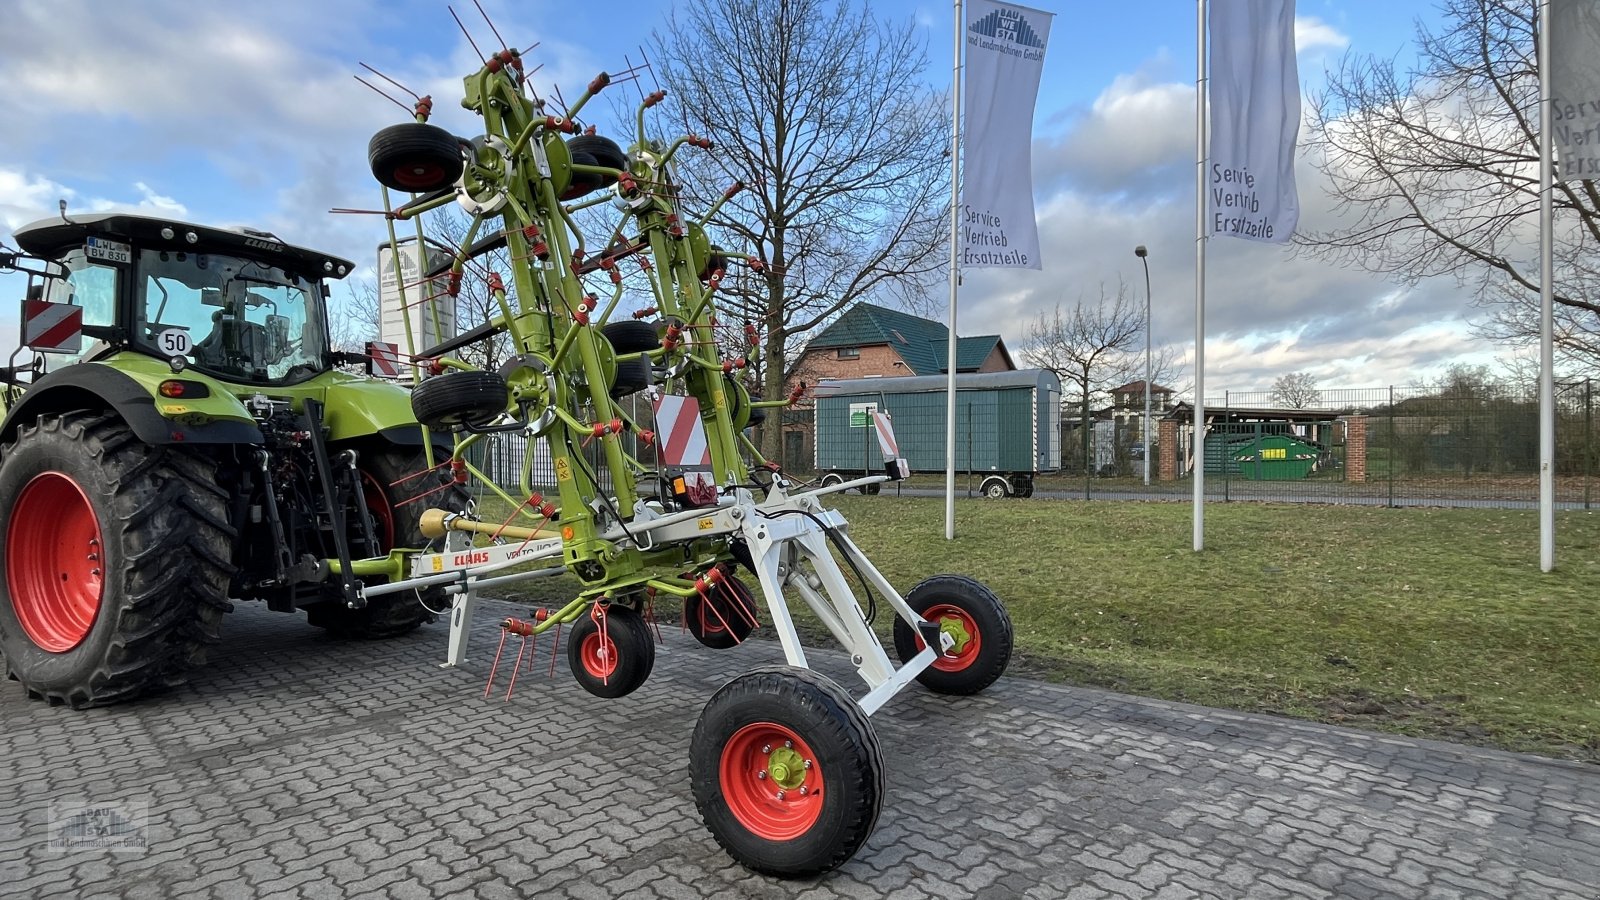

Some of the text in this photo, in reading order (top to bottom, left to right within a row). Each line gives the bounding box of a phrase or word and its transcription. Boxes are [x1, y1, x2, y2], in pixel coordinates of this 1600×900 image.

[1000, 8, 1019, 20] BAU
[1001, 19, 1016, 30] WE
[997, 29, 1015, 41] STA
[968, 36, 1044, 63] und Landmaschinen GmbH
[1213, 163, 1255, 189] Servie
[1213, 187, 1260, 213] Vertrib
[965, 204, 1001, 228] Service
[965, 225, 1008, 247] Vertrieb
[95, 239, 116, 251] LWL
[244, 237, 286, 252] CLAAS
[91, 248, 127, 262] BW 830
[964, 247, 1028, 265] Ersatzteile
[165, 333, 185, 352] 50
[454, 552, 489, 566] CLAAS
